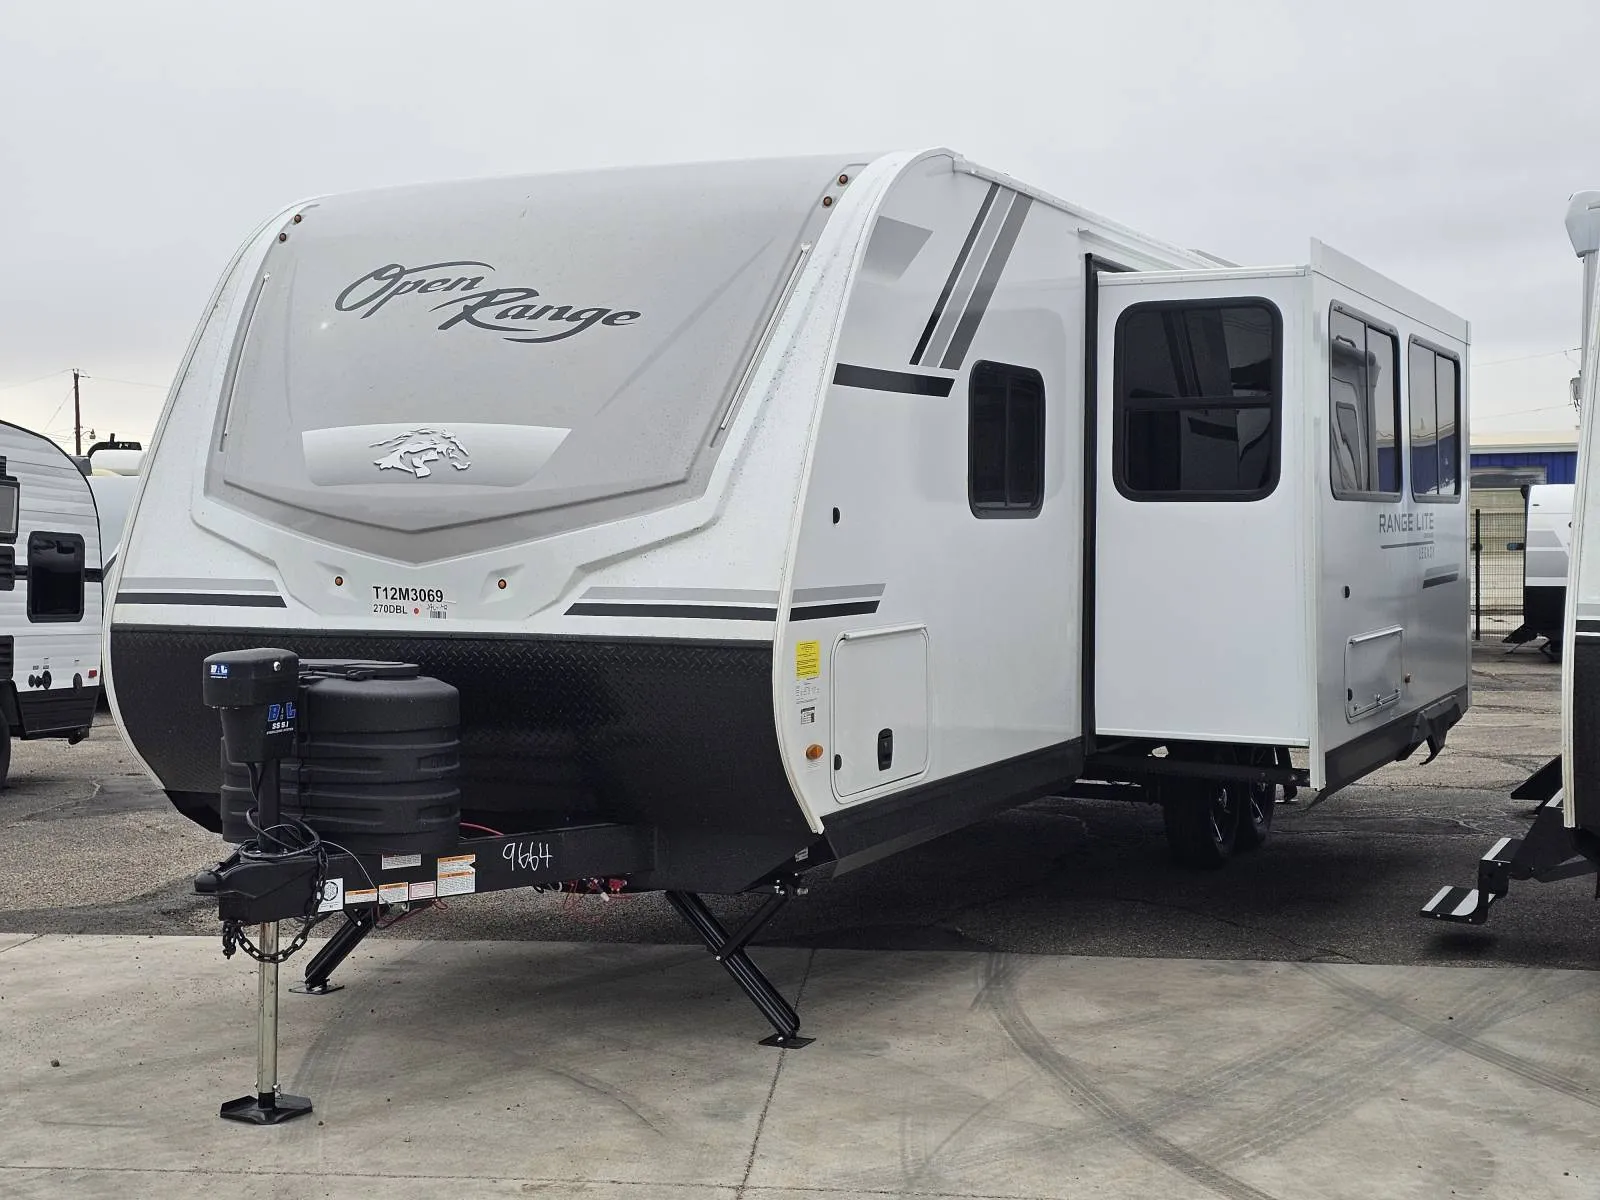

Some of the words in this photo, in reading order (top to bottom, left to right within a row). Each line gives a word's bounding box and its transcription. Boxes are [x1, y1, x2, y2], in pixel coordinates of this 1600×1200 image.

[334, 261, 495, 319] Open
[428, 287, 641, 343] Range
[1379, 513, 1413, 533] RANGE
[1416, 512, 1434, 531] LITE
[372, 586, 444, 602] T12M3069
[373, 603, 408, 615] 270DBL
[502, 842, 553, 871] 9664
